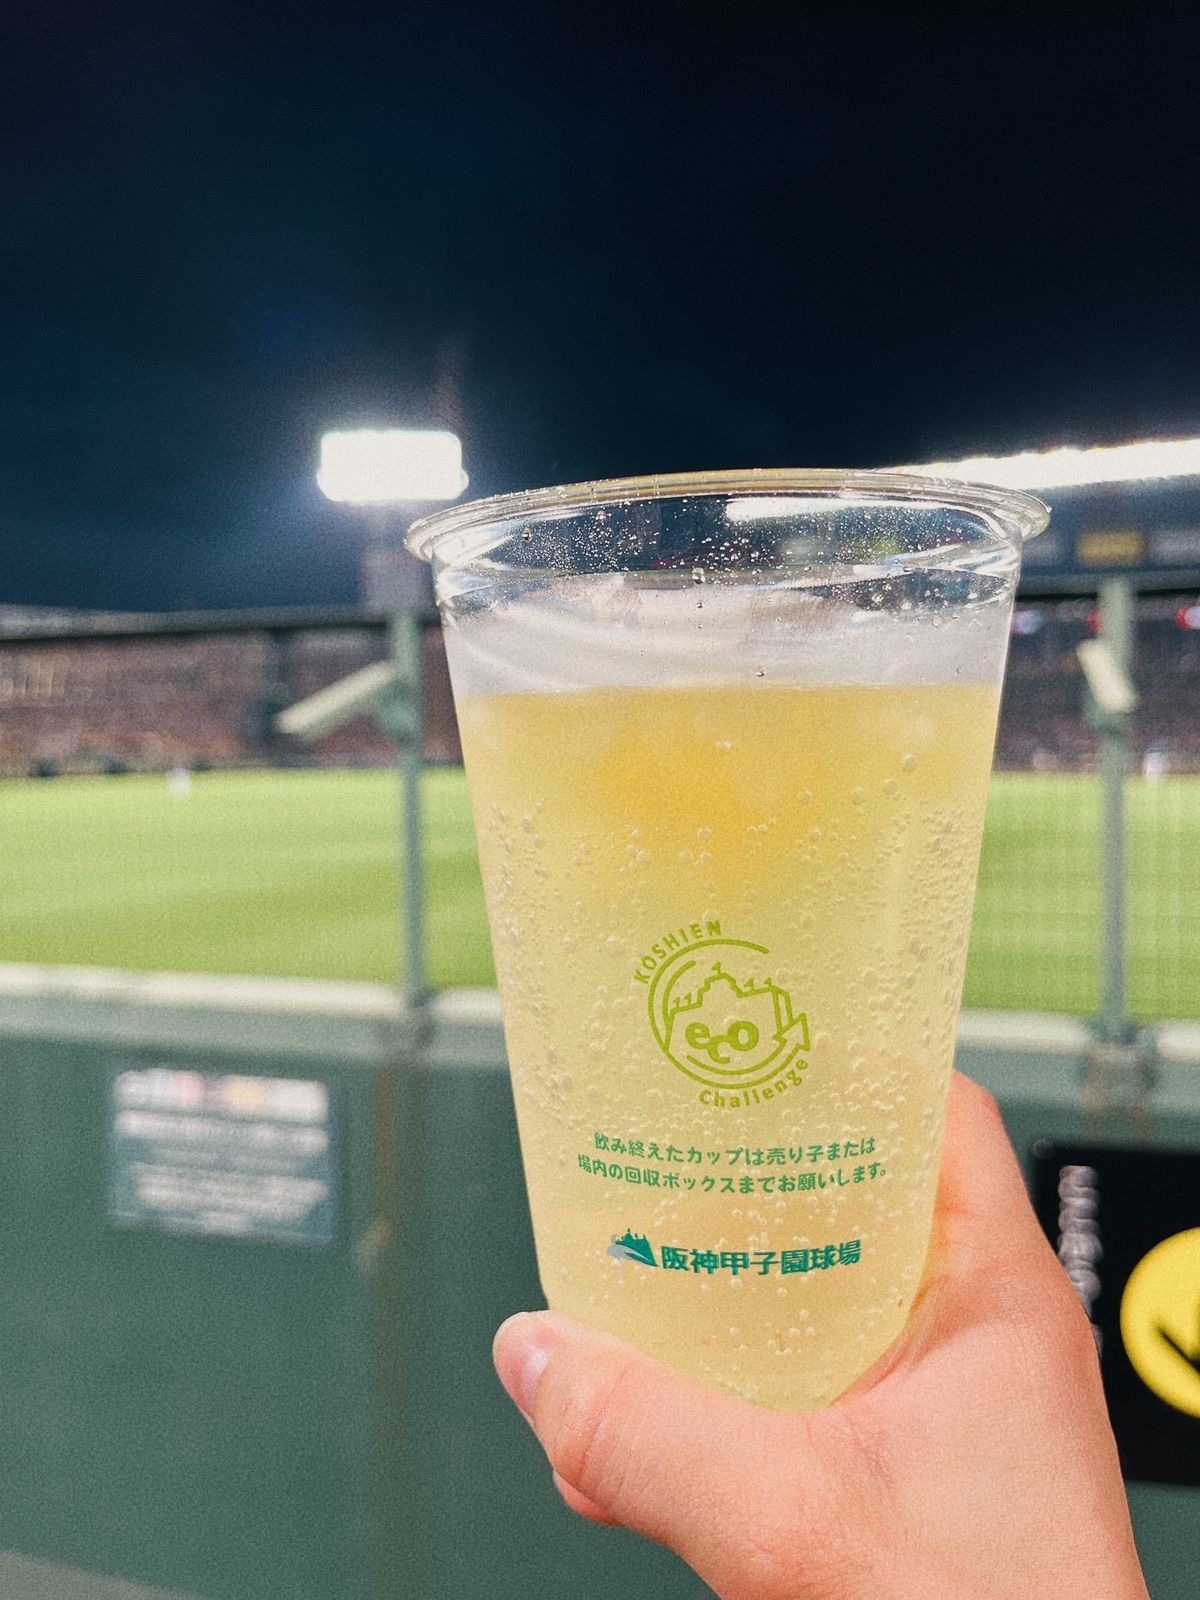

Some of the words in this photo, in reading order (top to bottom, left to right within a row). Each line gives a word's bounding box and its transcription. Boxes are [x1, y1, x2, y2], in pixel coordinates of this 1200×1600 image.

[633, 919, 722, 984] KOSHIEN
[685, 1020, 759, 1064] eco
[698, 1058, 809, 1108] Challenge
[594, 1131, 876, 1166] 飲み終えたカップは売り子または
[577, 1154, 887, 1194] 場内の回収ボックスまでお願いします。
[660, 1239, 862, 1275] 阪神甲子園球場
